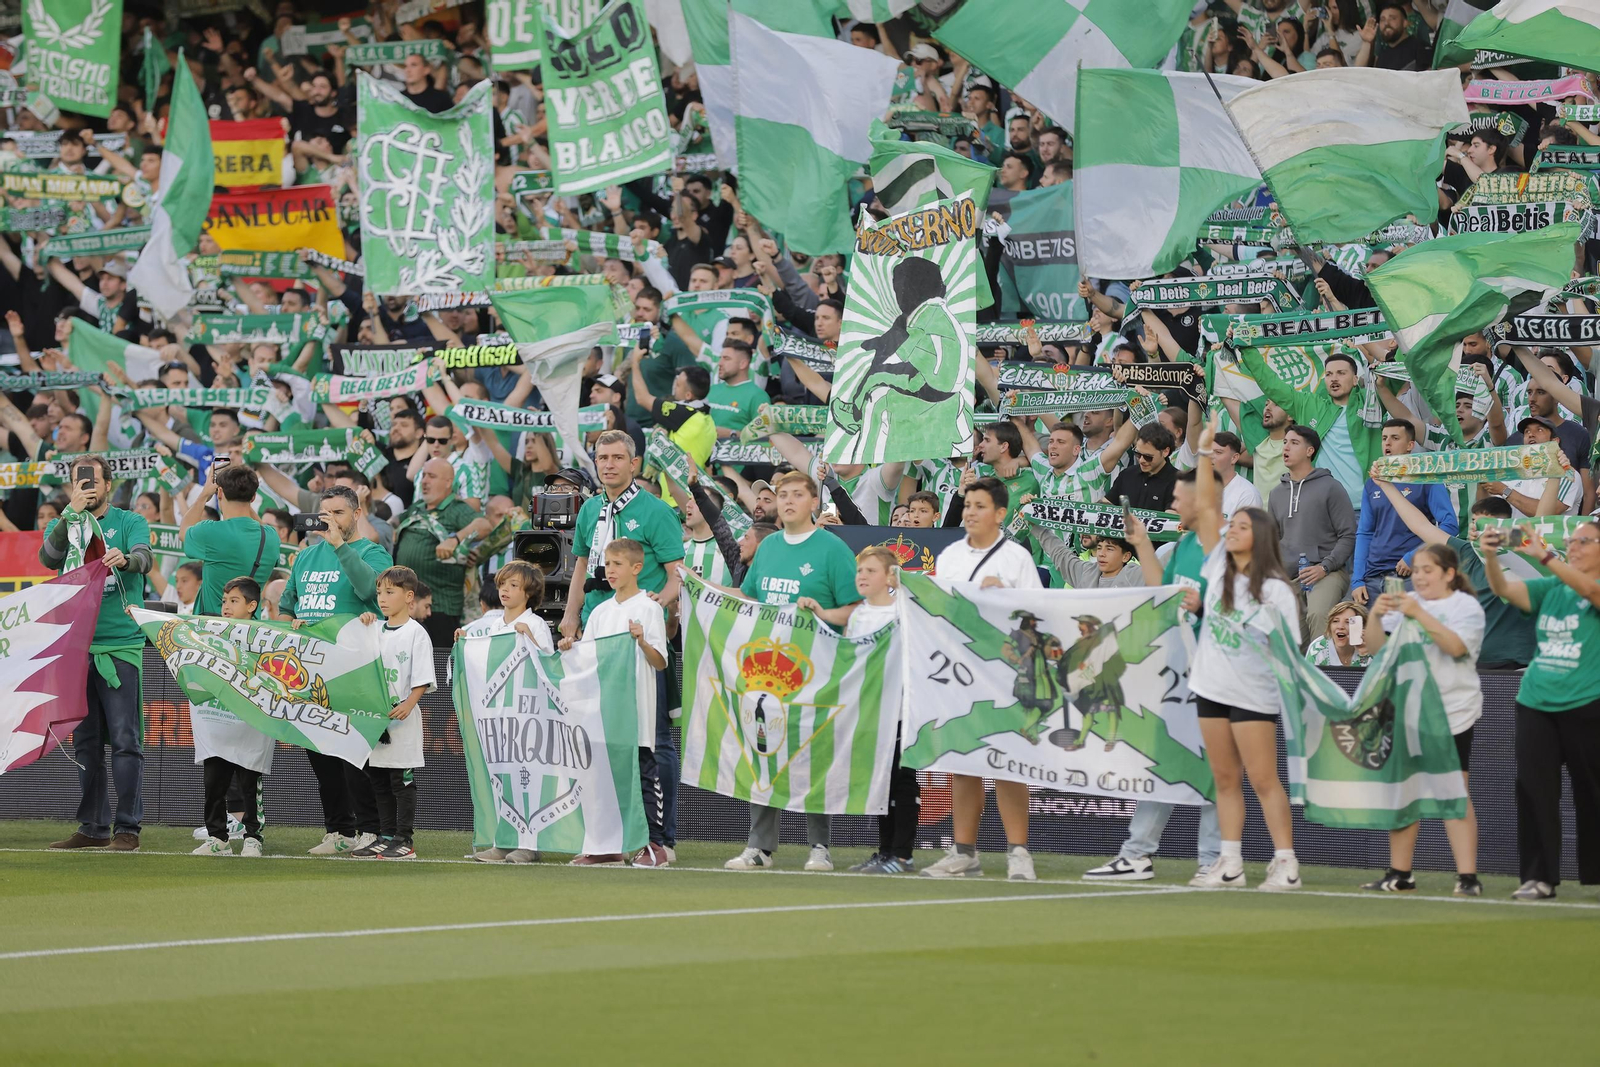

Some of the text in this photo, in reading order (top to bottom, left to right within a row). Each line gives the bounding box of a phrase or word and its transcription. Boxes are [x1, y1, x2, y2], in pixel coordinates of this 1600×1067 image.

[547, 57, 660, 129] VERDE
[554, 108, 669, 174] BLANCO
[1541, 151, 1592, 164] REAL
[4, 175, 121, 196] JUAN MIRANDA
[1479, 174, 1577, 193] REAL BETIS
[1160, 286, 1190, 299] Betis
[1217, 282, 1243, 297] Real
[1248, 279, 1278, 294] Betis
[1026, 292, 1079, 320] 1907
[1263, 310, 1382, 339] REAL BET
[1514, 317, 1572, 340] REAL
[340, 369, 417, 395] REAL BETIS
[464, 405, 510, 425] REAL
[770, 406, 822, 425] REAL
[109, 455, 160, 472] BETIS
[354, 447, 376, 469] 1907
[1408, 450, 1521, 475] REAL BETIS
[1031, 503, 1089, 526] REAL
[1043, 500, 1158, 518] DICEN QUE ESTMOS
[1039, 521, 1069, 532] LOCOS
[1071, 525, 1091, 534] DE
[1093, 528, 1107, 536] LA
[309, 570, 340, 582] BETIS
[769, 577, 801, 594] BETIS
[704, 591, 753, 617] BÉTICA
[188, 618, 325, 664] RAHAL
[927, 650, 974, 687] 20
[517, 695, 541, 715] EL
[986, 747, 1058, 784] Tercio
[1096, 771, 1156, 795] Coro
